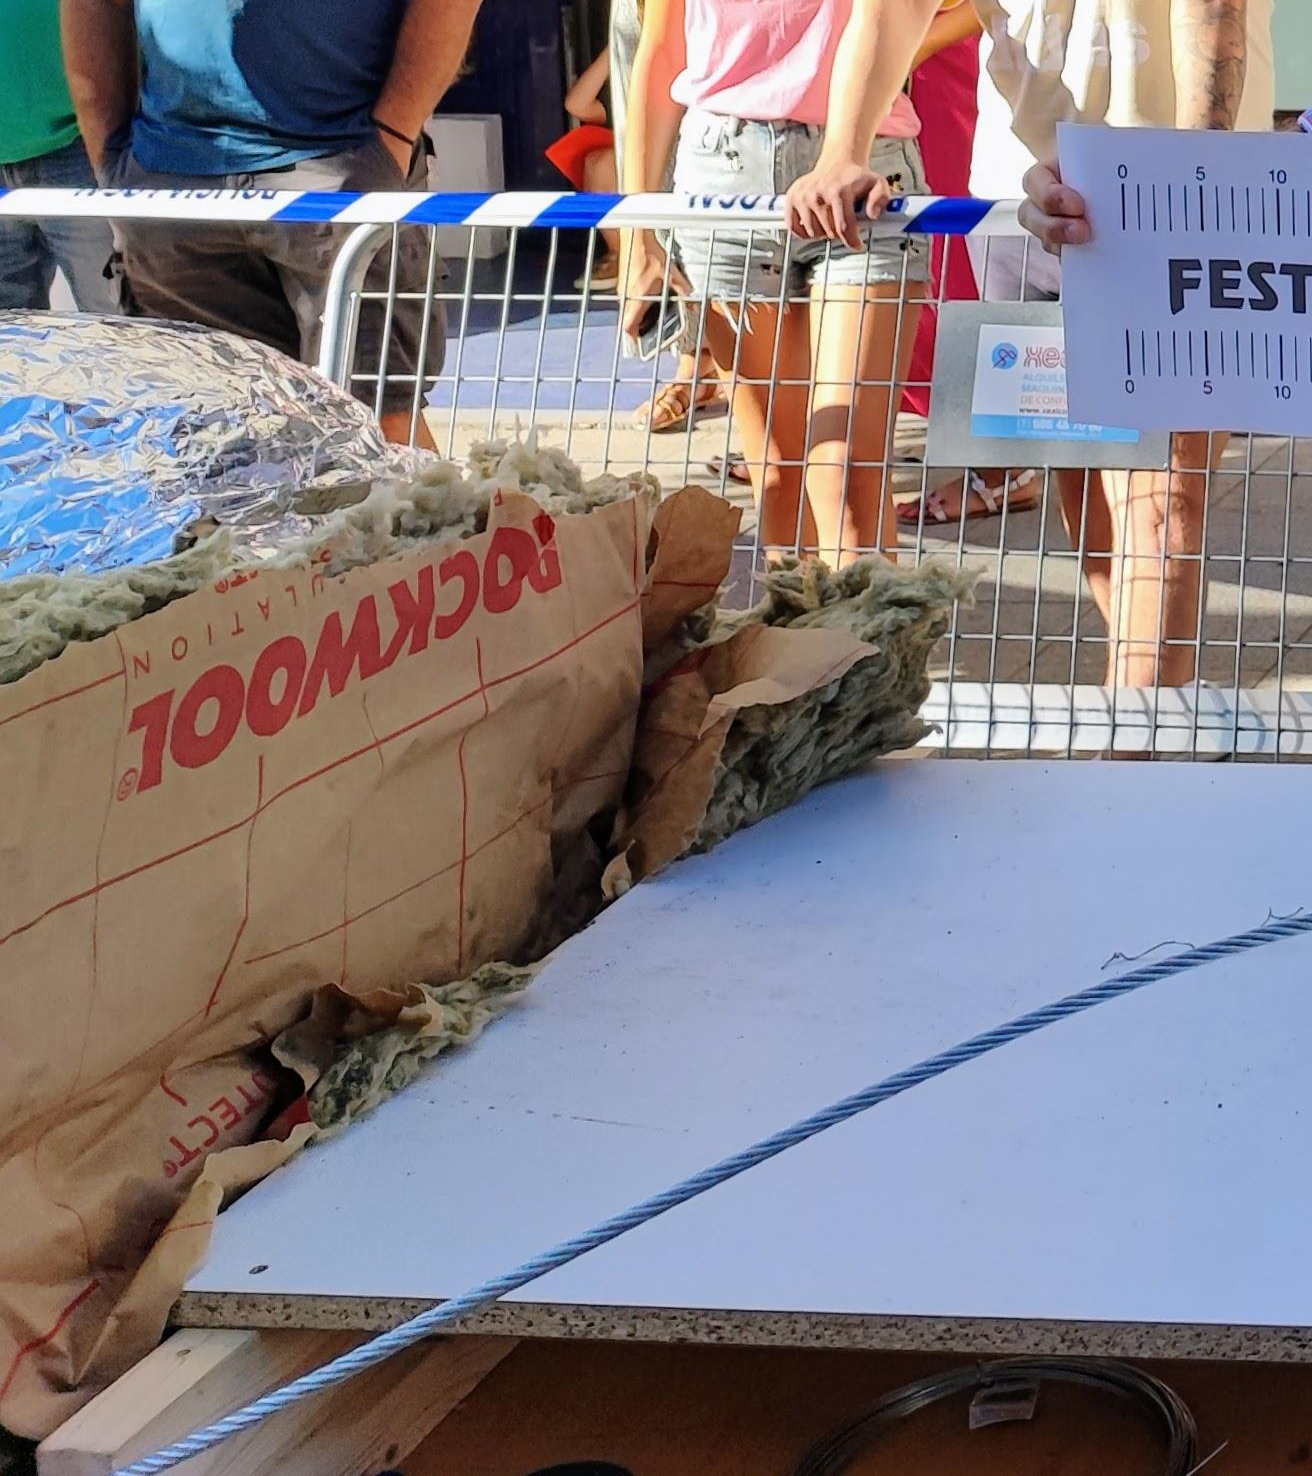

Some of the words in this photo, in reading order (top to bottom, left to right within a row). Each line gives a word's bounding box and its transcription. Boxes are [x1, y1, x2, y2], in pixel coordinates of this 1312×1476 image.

[1117, 163, 1128, 180] 0
[1195, 165, 1206, 182] 5
[1268, 169, 1287, 185] 10
[1124, 379, 1135, 395] 0
[1202, 379, 1213, 396] 5
[1274, 385, 1292, 400] 10
